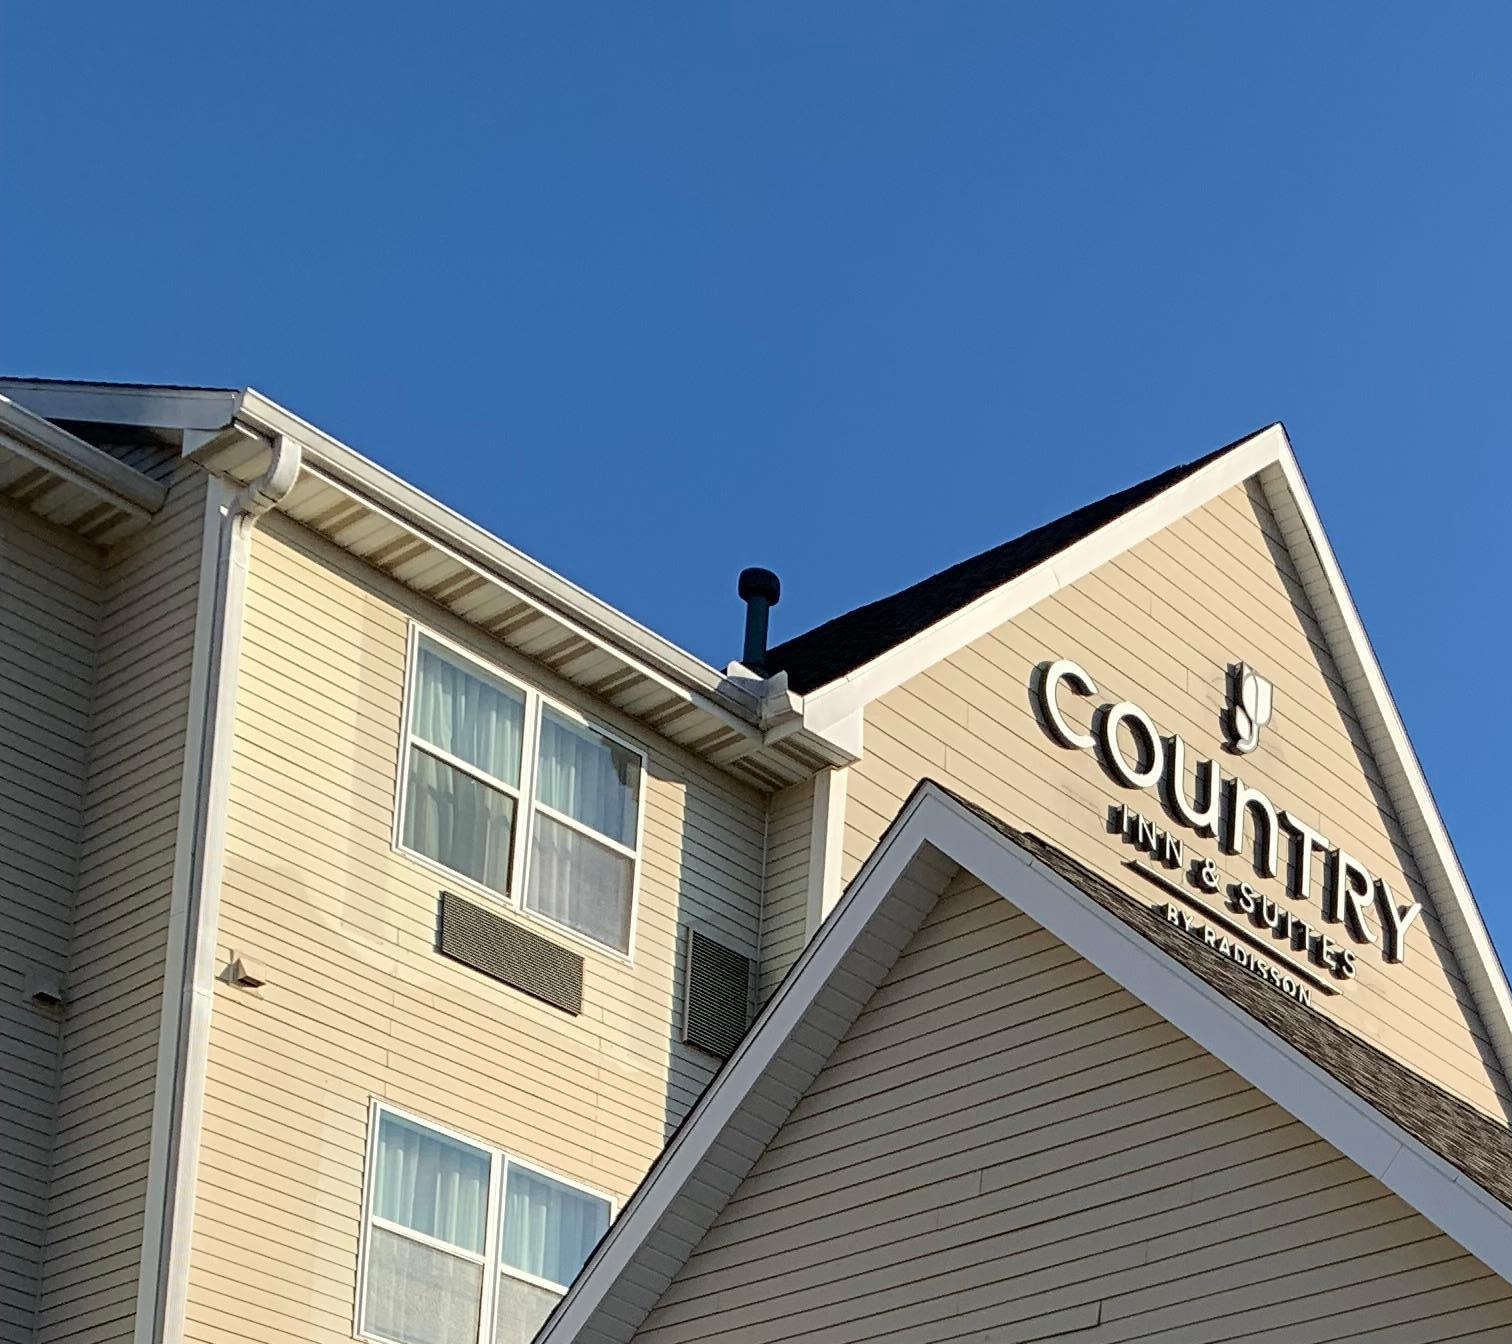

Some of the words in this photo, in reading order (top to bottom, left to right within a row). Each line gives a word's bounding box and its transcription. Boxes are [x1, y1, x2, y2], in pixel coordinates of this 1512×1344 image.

[1122, 803, 1184, 868] INN
[1202, 857, 1222, 891] &
[1239, 883, 1357, 979] SUITES
[1166, 903, 1194, 931] BY
[1204, 924, 1312, 1006] RADISSON
